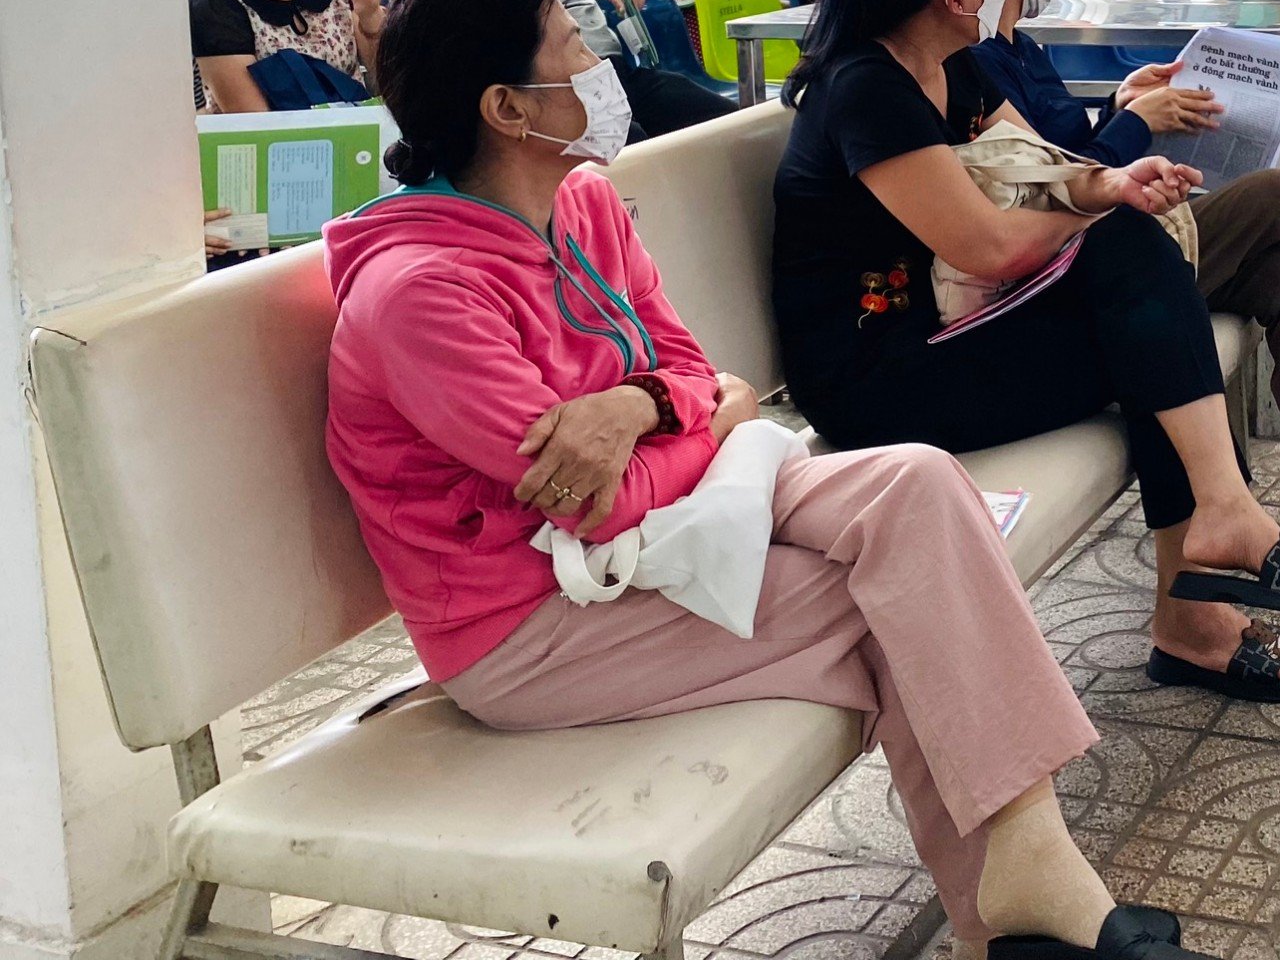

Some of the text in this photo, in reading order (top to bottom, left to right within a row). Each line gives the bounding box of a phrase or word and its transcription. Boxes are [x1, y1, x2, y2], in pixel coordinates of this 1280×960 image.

[1227, 51, 1254, 63] mạch
[1256, 57, 1280, 69] vành
[1201, 65, 1224, 80] động
[1227, 71, 1253, 84] mạch
[1255, 78, 1279, 90] vành
